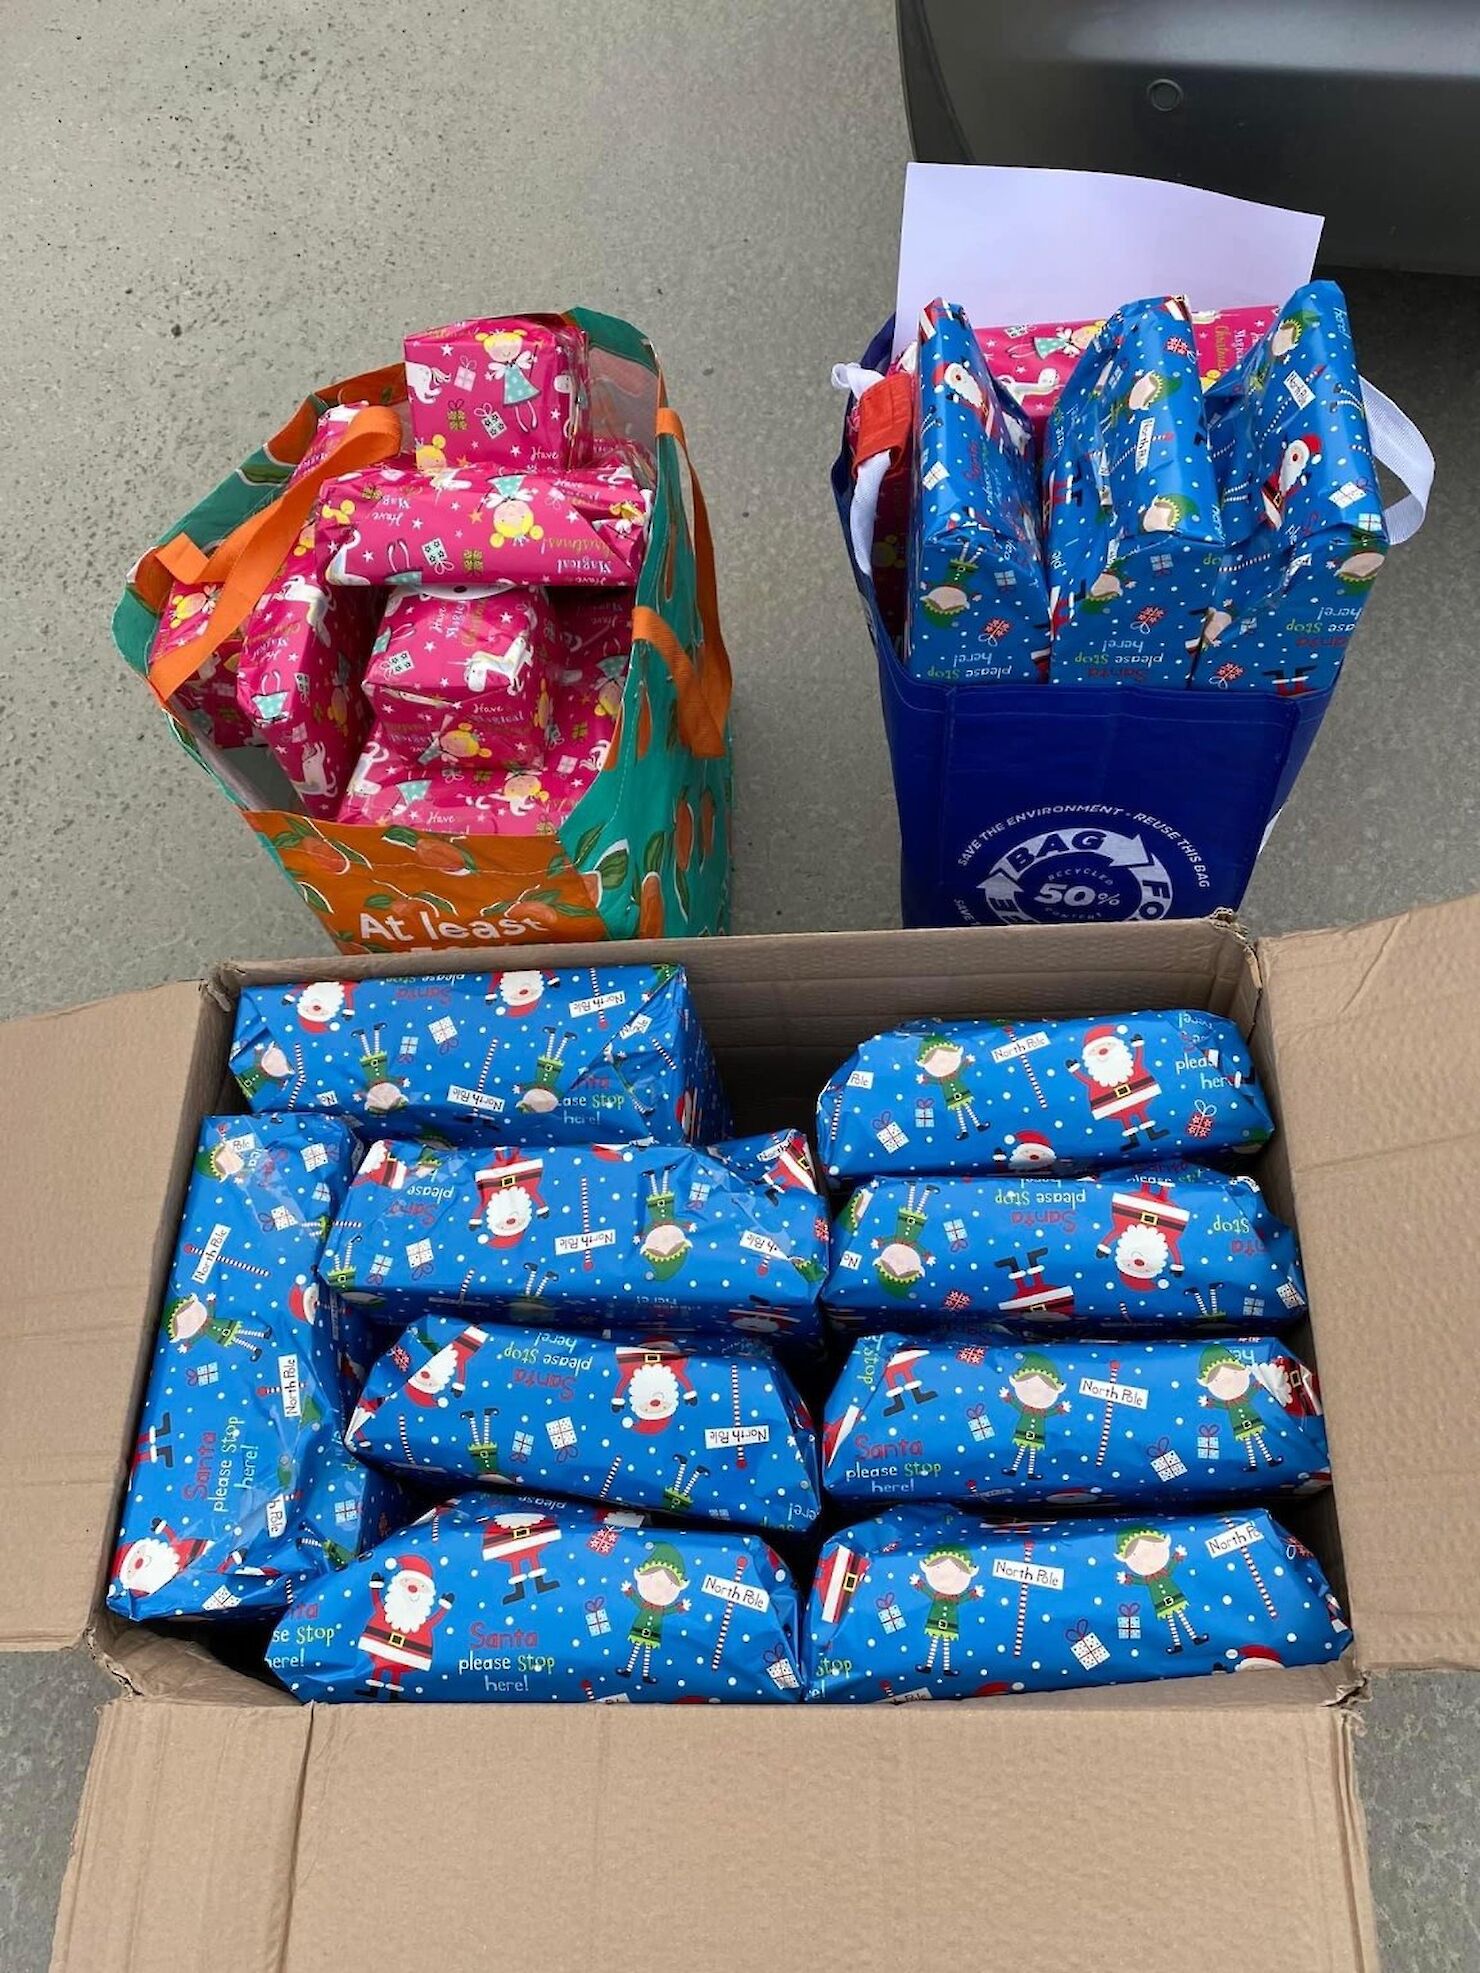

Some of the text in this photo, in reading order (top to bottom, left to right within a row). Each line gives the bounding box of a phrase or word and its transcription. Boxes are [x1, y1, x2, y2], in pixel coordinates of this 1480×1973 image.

[557, 558, 613, 575] Magical
[966, 665, 1013, 679] please
[1115, 652, 1164, 668] please
[958, 804, 1211, 888] SAVE THE ENVIRONMENT REUSE THIS BAG
[1006, 830, 1107, 875] BAG
[1048, 867, 1114, 886] RECYCLED
[1033, 883, 1120, 907] 50%
[1137, 879, 1171, 920] FO
[359, 910, 550, 942] At least
[573, 993, 624, 1012] North Pole
[994, 1042, 1026, 1060] North
[452, 1088, 503, 1111] North Pole
[407, 1184, 455, 1204] please
[1036, 1189, 1087, 1211] please
[1011, 1210, 1077, 1233] Santa
[560, 1231, 614, 1250] North Pole
[195, 1227, 228, 1281] North Pole
[535, 1331, 577, 1353] here!
[543, 1352, 593, 1376] please
[282, 1358, 298, 1415] North Pole
[512, 1368, 577, 1401] Santa
[1082, 1379, 1144, 1406] North Pole
[709, 1428, 768, 1443] North Pole
[854, 1434, 924, 1460] Santa
[183, 1431, 217, 1500] Santa
[234, 1444, 259, 1490] here!
[846, 1461, 898, 1482] please
[208, 1456, 233, 1513] please
[871, 1479, 915, 1493] here!
[787, 1503, 819, 1521] ere!
[1208, 1529, 1248, 1553] North
[996, 1561, 1060, 1587] North Pole
[705, 1577, 765, 1609] North Pole
[470, 1622, 538, 1650] Santa
[458, 1650, 511, 1675] please
[484, 1675, 529, 1692] here!
